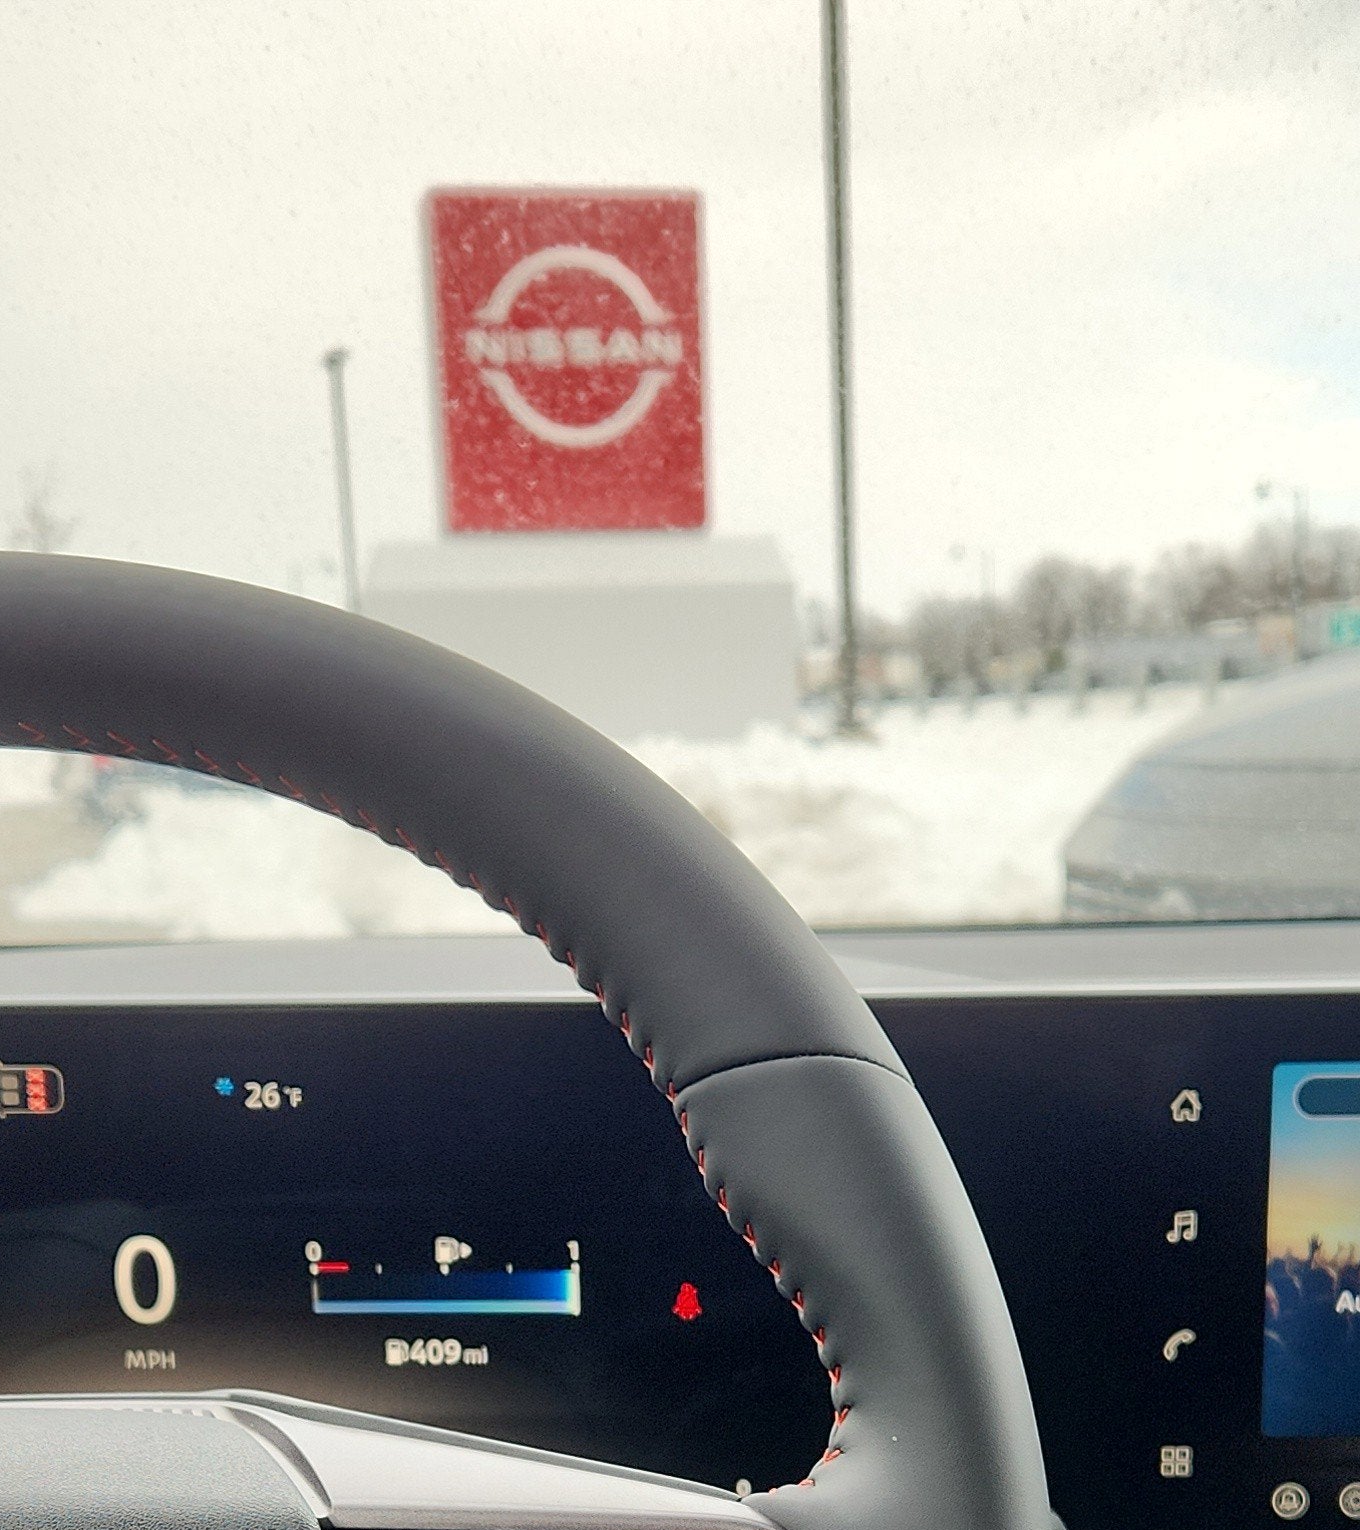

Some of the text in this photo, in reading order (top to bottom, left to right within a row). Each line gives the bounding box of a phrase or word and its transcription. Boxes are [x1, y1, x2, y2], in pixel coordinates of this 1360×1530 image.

[305, 1240, 323, 1262] 0
[566, 1239, 580, 1261] 1
[114, 1234, 176, 1325] 0
[124, 1350, 176, 1370] MPH
